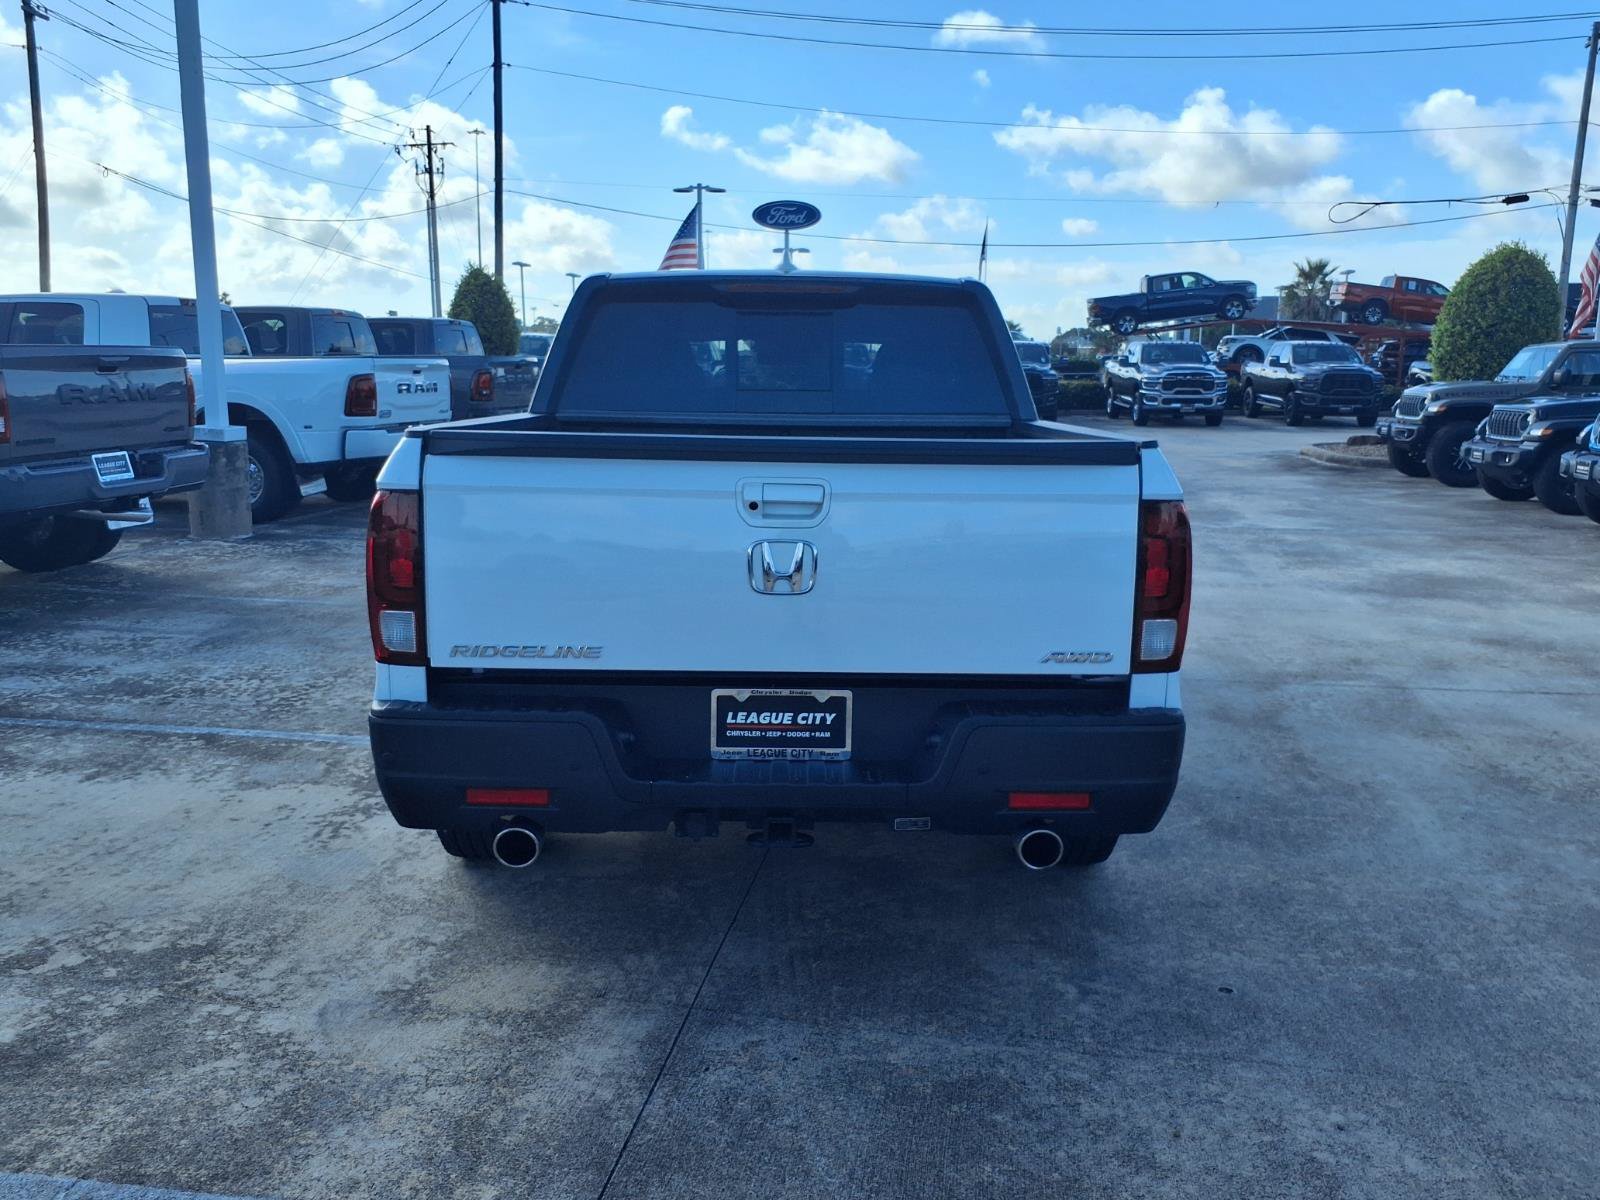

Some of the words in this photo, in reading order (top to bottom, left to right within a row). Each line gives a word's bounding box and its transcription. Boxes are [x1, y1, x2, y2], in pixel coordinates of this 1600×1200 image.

[766, 206, 808, 225] Ford
[56, 382, 158, 405] RAM
[396, 383, 439, 395] RAM
[449, 644, 603, 659] RIDGELINE
[1040, 651, 1114, 664] AWD
[726, 711, 794, 725] LEAGUE
[796, 712, 837, 725] CITY
[747, 748, 788, 758] LEAGUE
[790, 749, 815, 758] CITY
